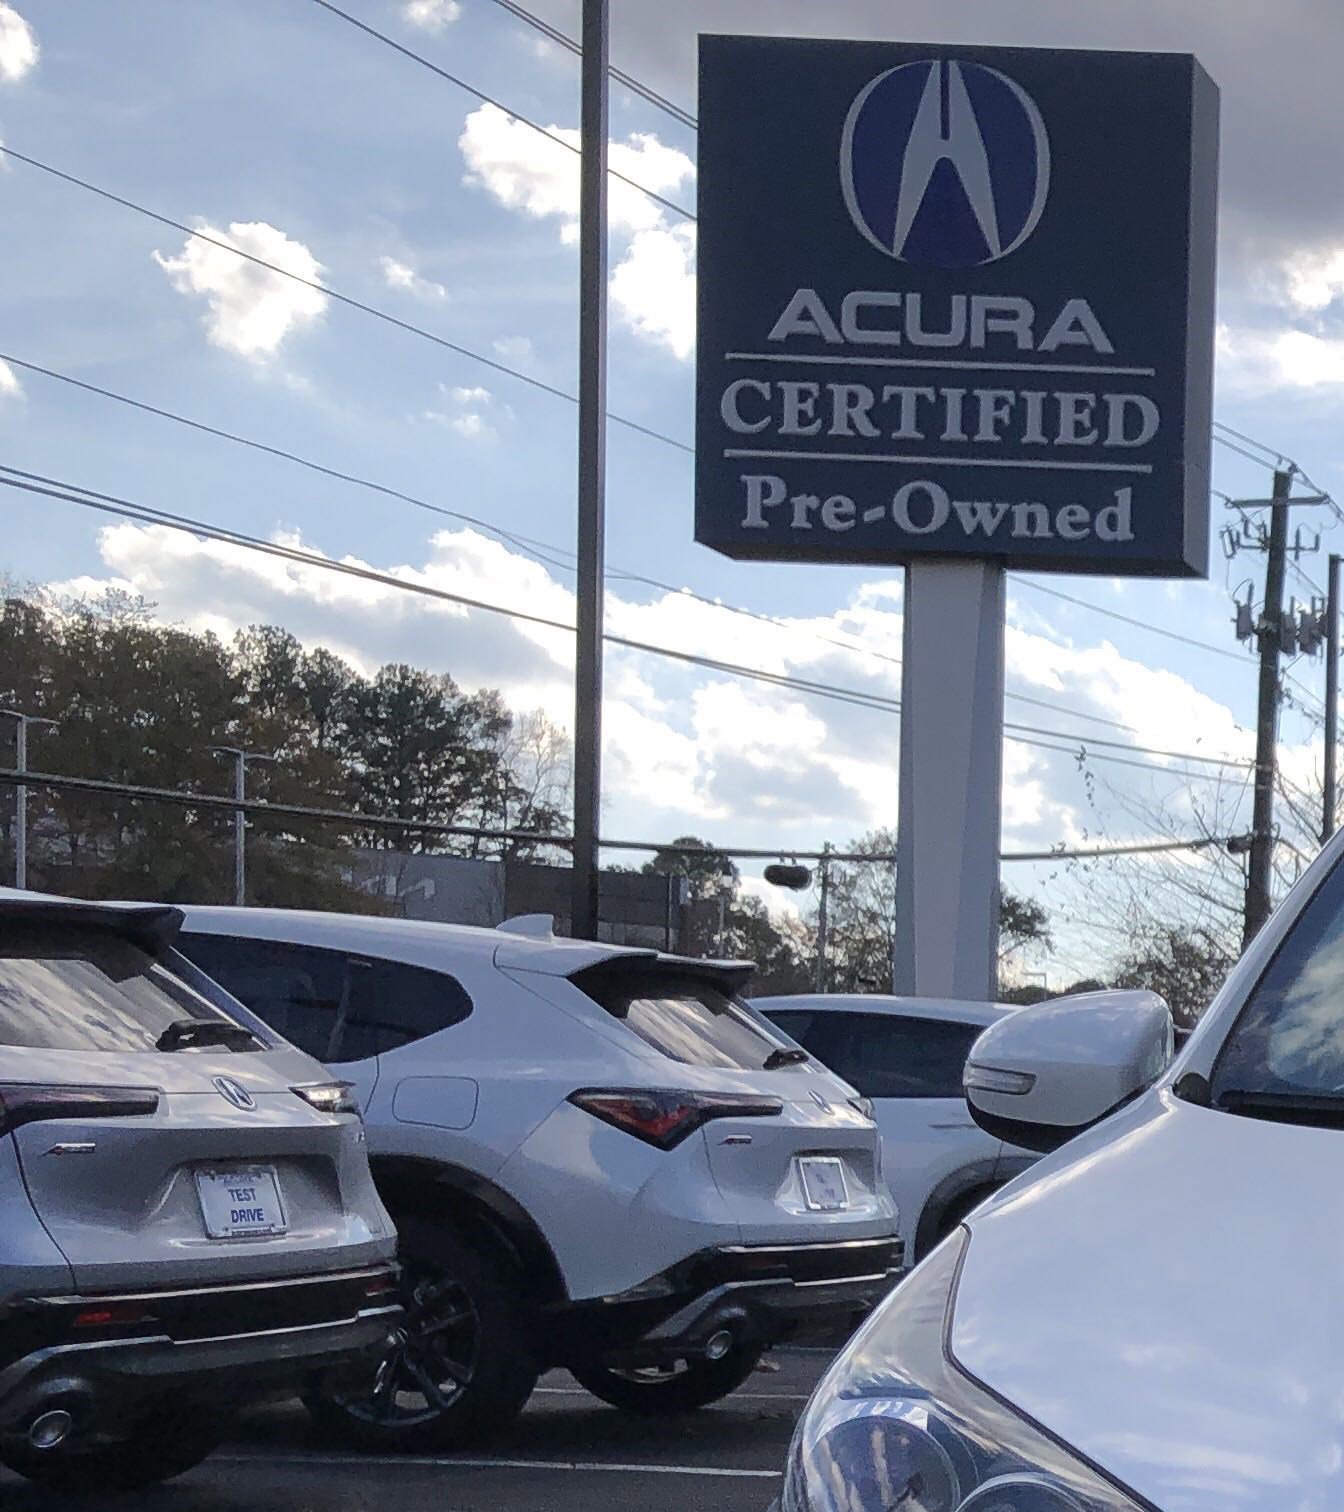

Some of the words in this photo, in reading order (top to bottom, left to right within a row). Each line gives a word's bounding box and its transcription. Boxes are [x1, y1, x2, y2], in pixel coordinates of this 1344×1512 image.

[767, 288, 1115, 354] ACURA
[720, 379, 1160, 448] CERTIFIED
[740, 475, 1134, 541] Pre-Owned
[228, 1187, 256, 1202] TEST
[231, 1208, 264, 1223] DRIVE
